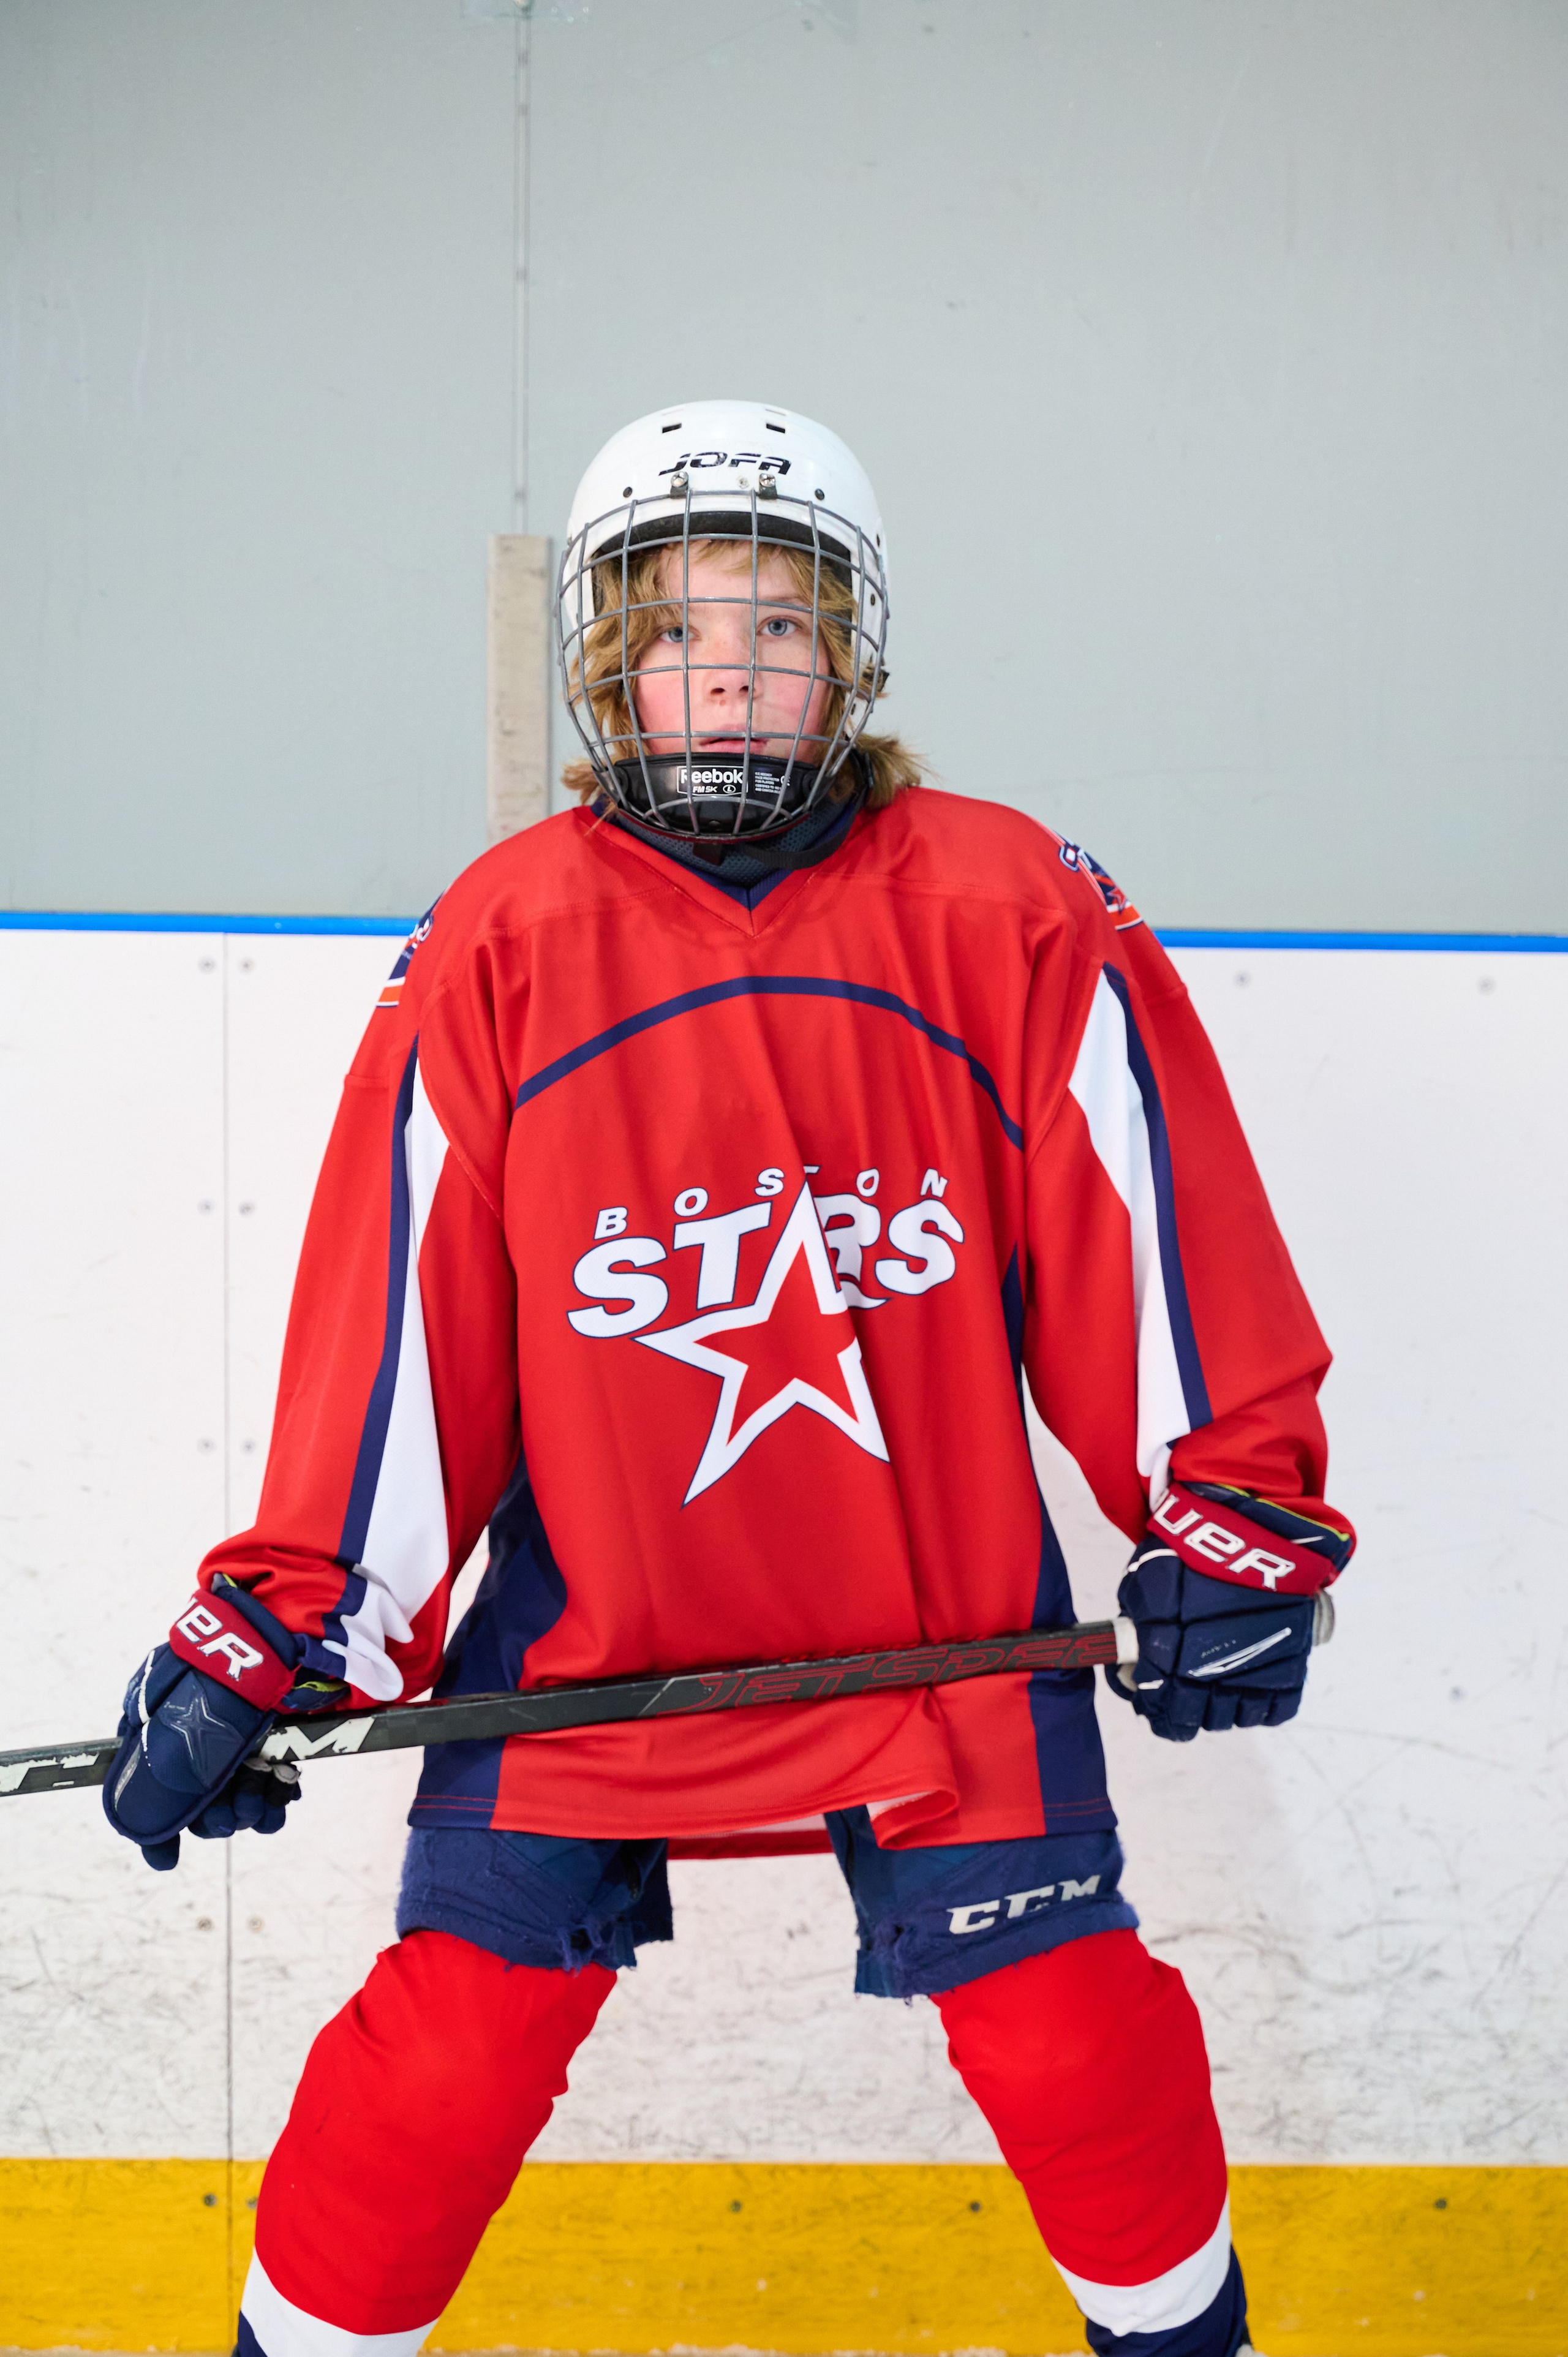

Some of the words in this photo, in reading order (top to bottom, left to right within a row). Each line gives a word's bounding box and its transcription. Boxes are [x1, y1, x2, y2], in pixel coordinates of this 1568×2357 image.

[658, 451, 792, 476] JOFA
[680, 768, 744, 784] Reebok
[567, 1180, 965, 1341] STARS
[946, 1874, 1101, 1934] CCM
